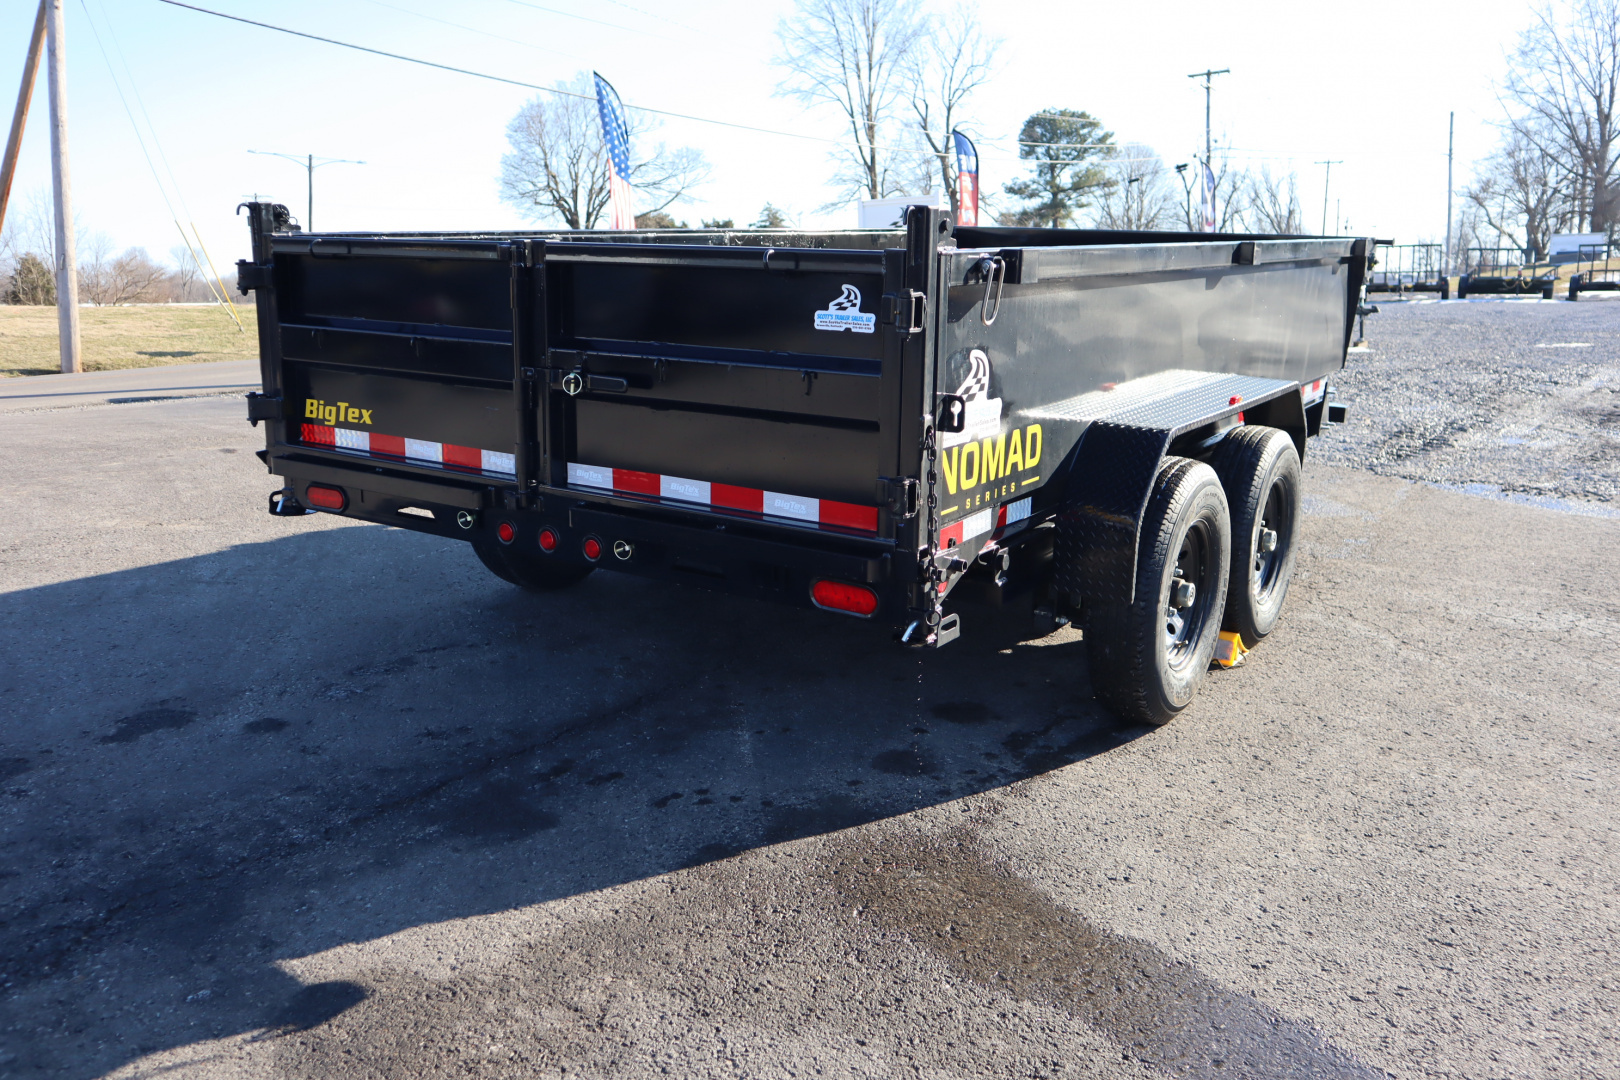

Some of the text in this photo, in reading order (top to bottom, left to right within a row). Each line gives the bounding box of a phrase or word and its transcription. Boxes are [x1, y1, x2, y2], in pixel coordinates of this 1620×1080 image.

[304, 398, 373, 426] BigTex
[942, 423, 1043, 496] NOMAD
[576, 469, 603, 480] BigTex
[670, 482, 700, 494] BigTex
[965, 481, 1016, 510] SERIES
[774, 498, 807, 511] BigTex
